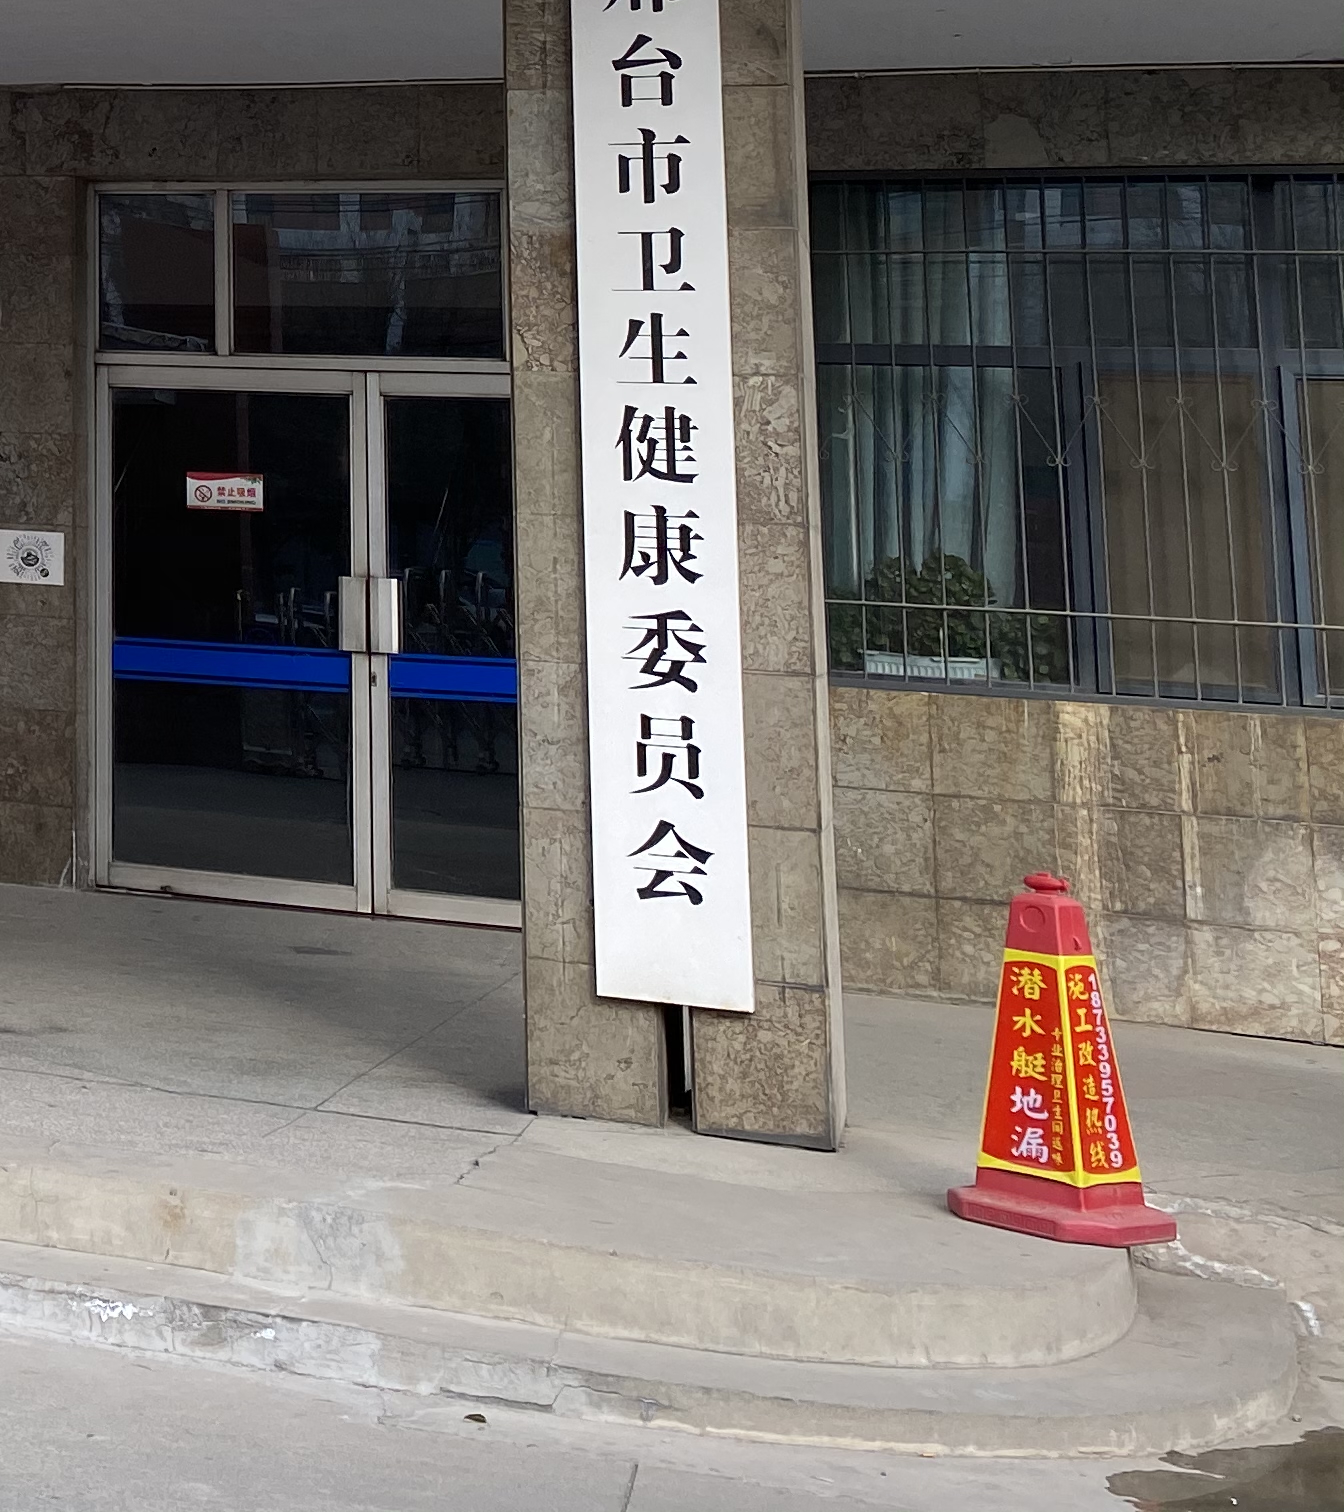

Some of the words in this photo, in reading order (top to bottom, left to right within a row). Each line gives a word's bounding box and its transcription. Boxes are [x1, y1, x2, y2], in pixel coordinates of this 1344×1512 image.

[1009, 966, 1049, 1163] 潜水艇地漏
[1068, 973, 1109, 1169] 施工改造热线
[1088, 972, 1124, 1169] 18733957039
